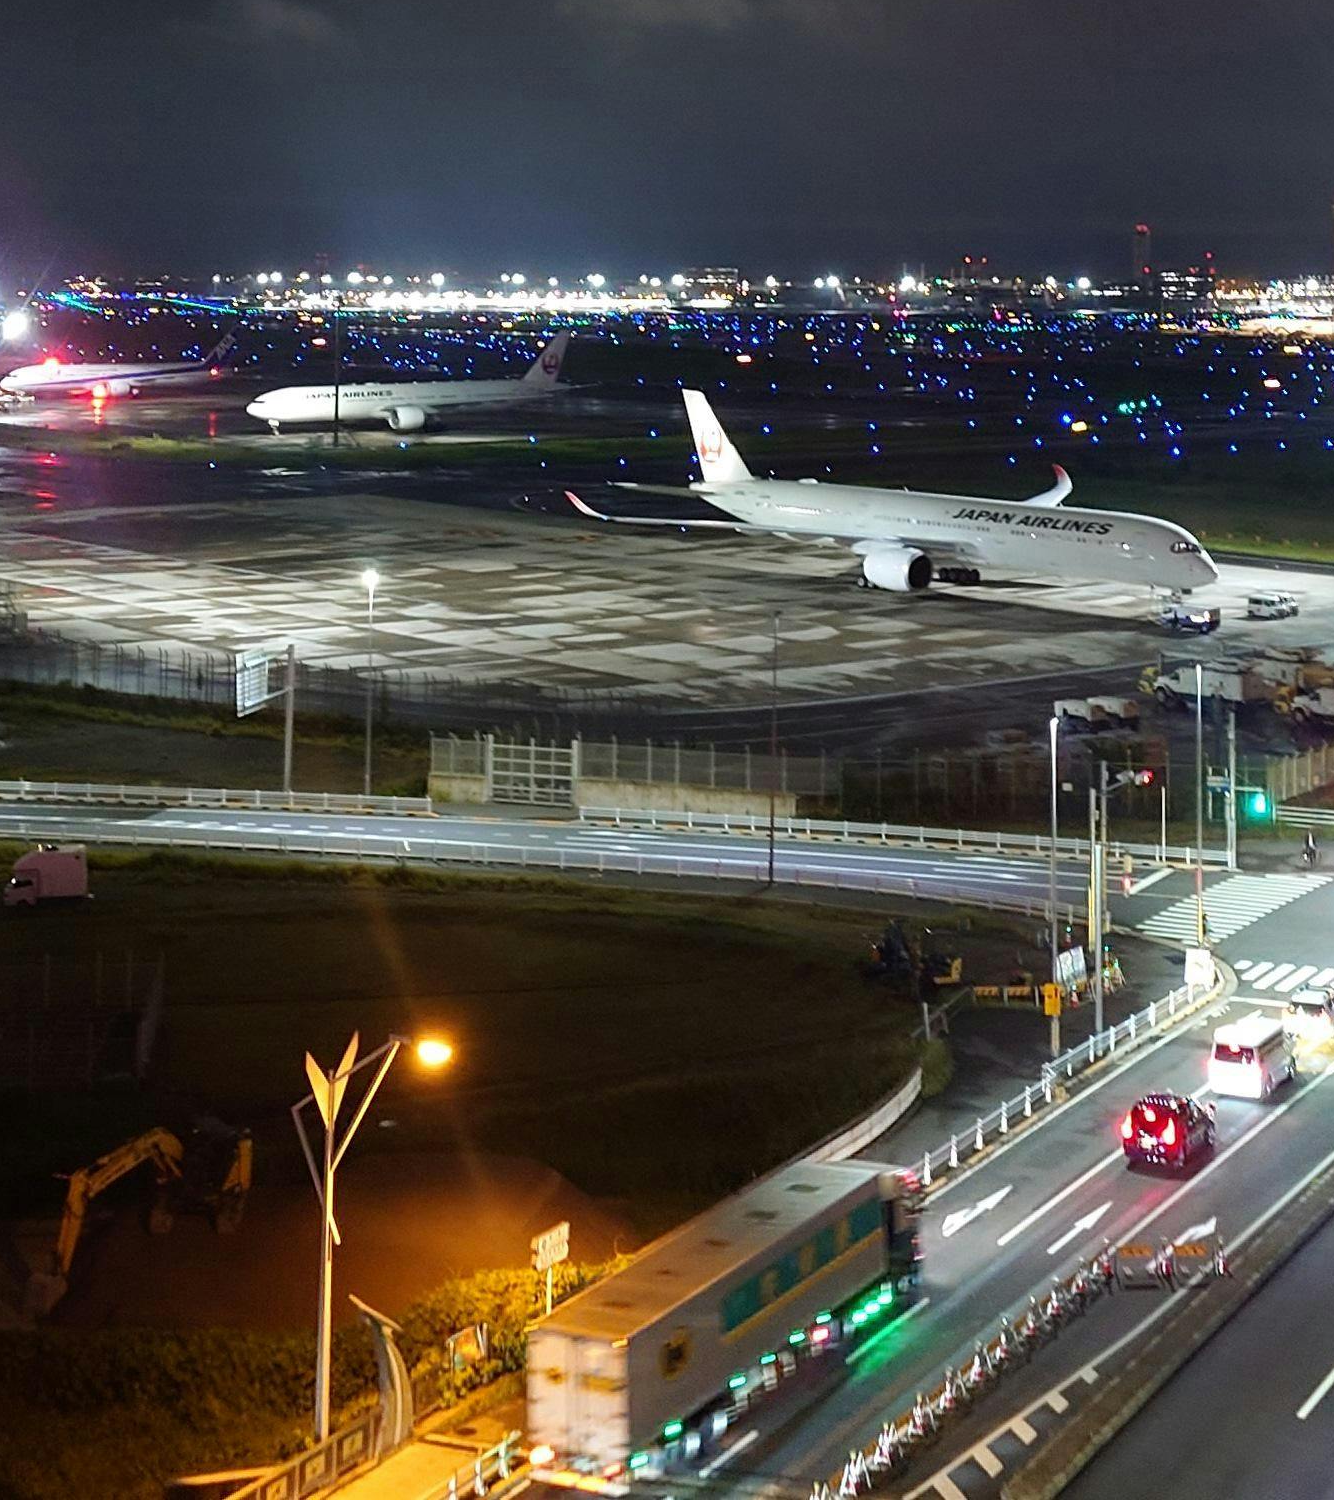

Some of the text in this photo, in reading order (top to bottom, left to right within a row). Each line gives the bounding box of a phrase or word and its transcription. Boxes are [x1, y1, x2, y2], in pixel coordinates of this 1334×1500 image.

[342, 389, 393, 398] AIRLINES
[952, 508, 1114, 535] JAPAN AIRLINES
